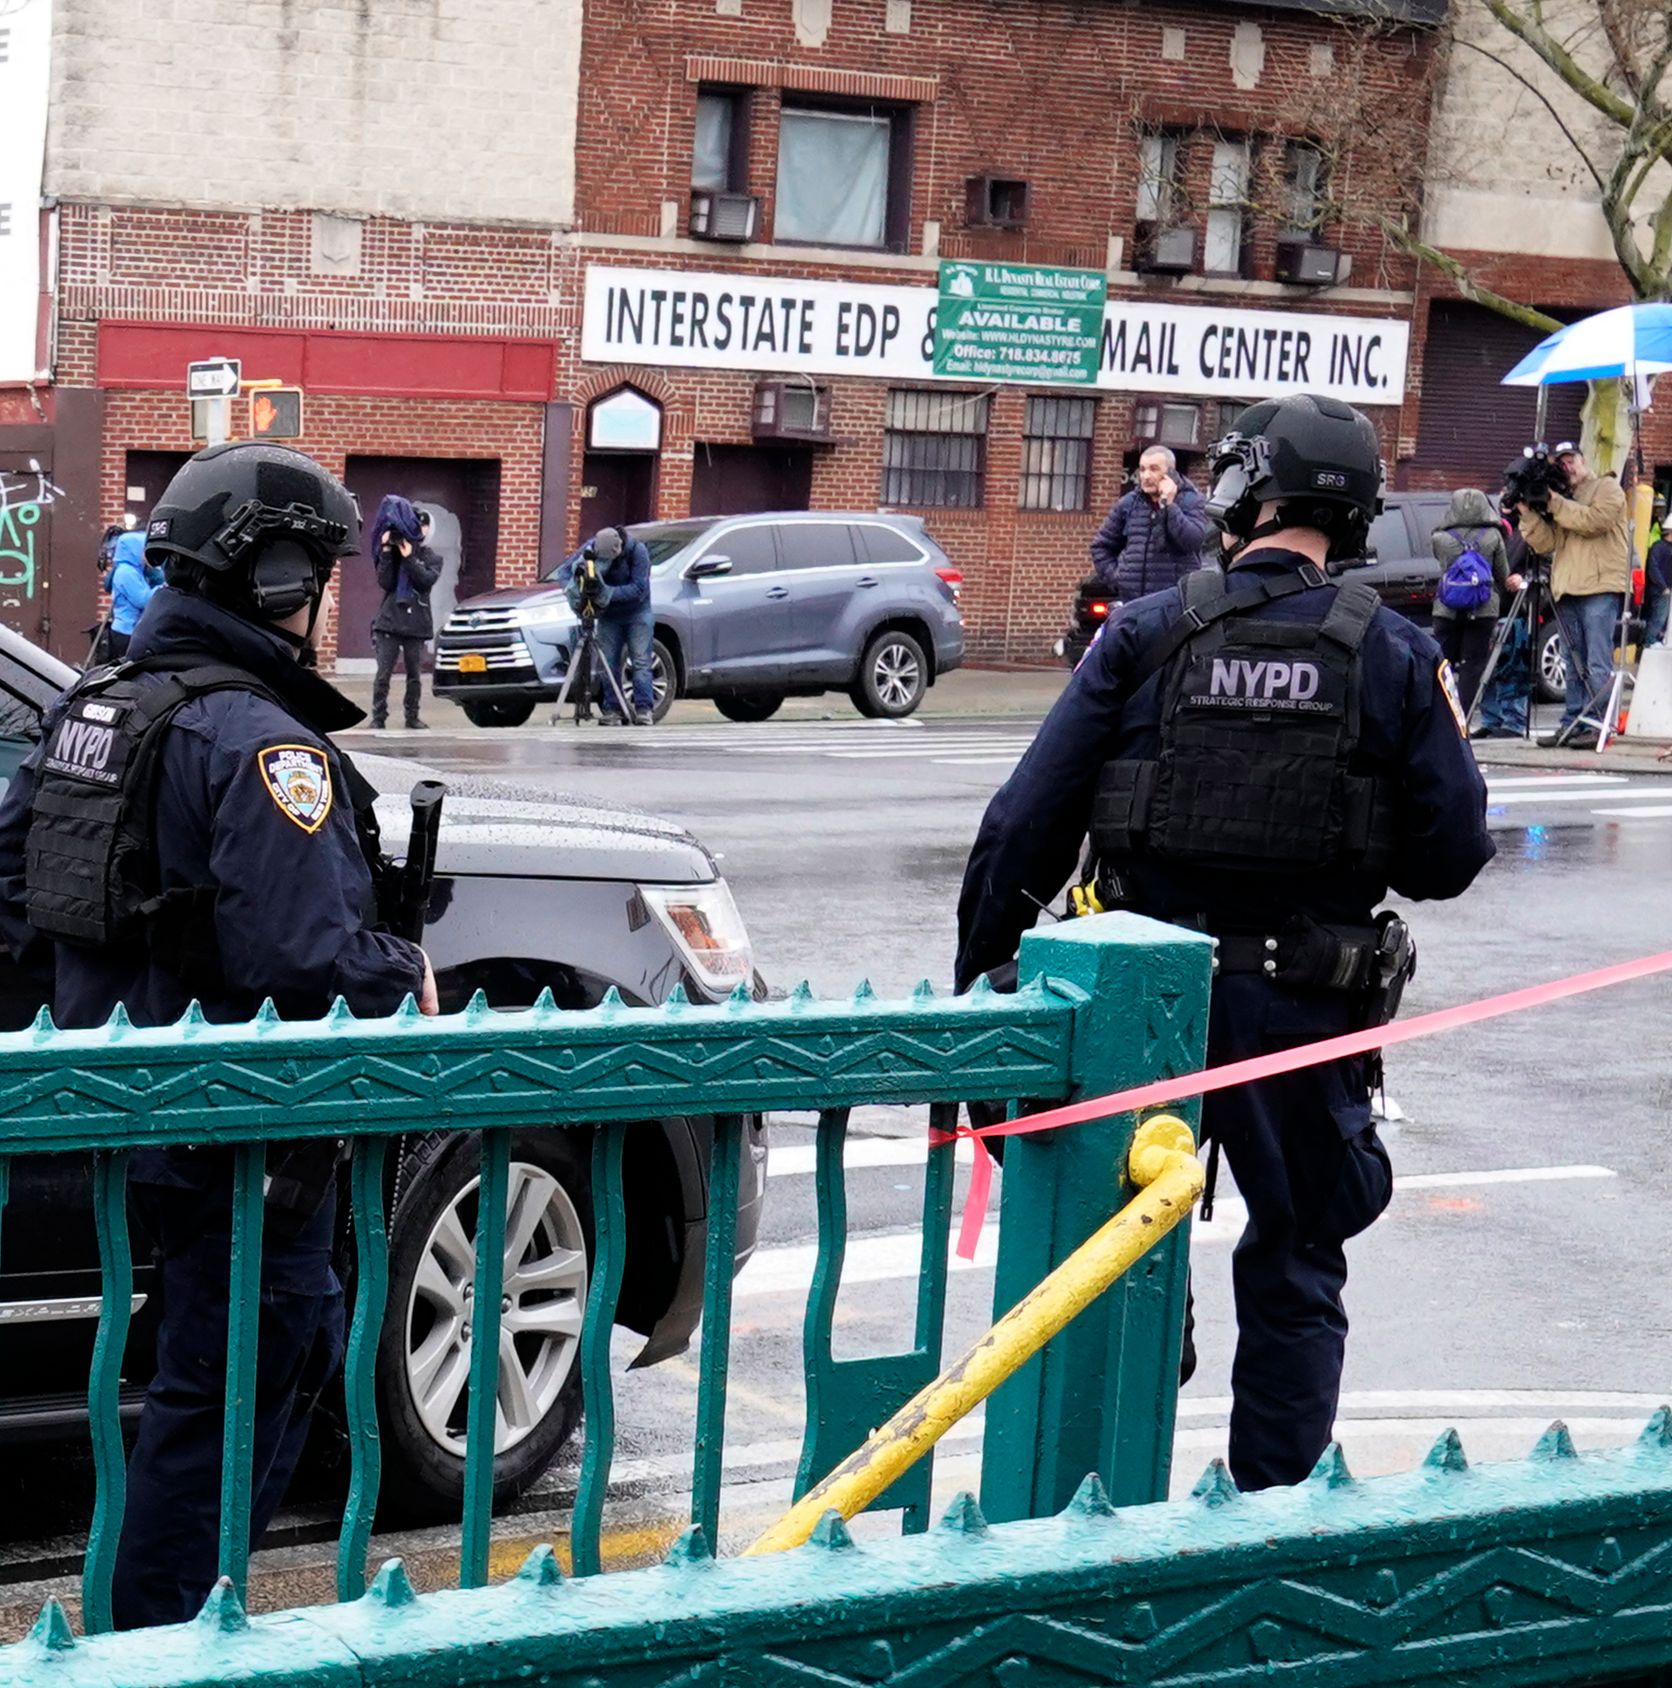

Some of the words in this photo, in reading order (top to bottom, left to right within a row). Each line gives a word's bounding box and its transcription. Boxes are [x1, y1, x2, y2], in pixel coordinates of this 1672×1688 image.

[958, 311, 1081, 332] AVAILABLE
[606, 287, 816, 354] INTERSTATE
[835, 302, 900, 359] EDP
[1099, 318, 1179, 375] MAIL
[1199, 323, 1311, 384] CENTER
[1329, 334, 1388, 388] INC.
[953, 344, 995, 360] Office:
[1316, 473, 1347, 488] SRG
[1210, 659, 1319, 700] NYPD
[1190, 695, 1244, 707] STRATEGIC
[1245, 698, 1297, 710] RESPONSE
[1298, 702, 1333, 712] GROUP
[54, 719, 114, 770] NYPD
